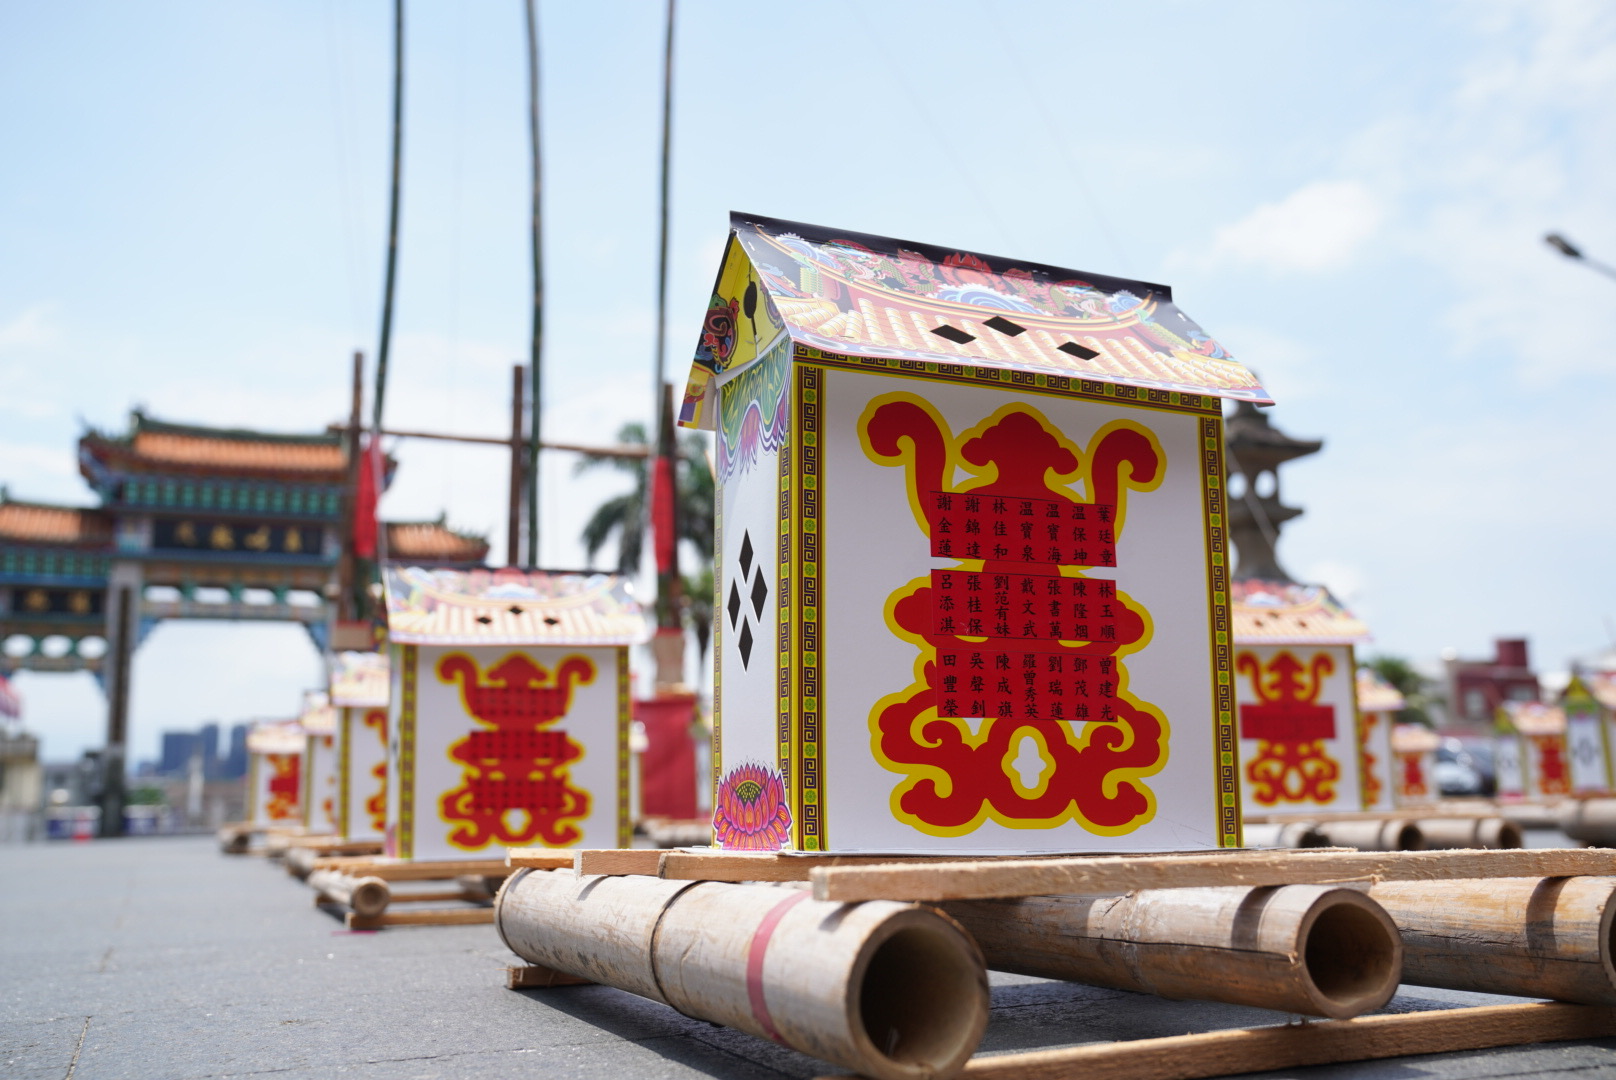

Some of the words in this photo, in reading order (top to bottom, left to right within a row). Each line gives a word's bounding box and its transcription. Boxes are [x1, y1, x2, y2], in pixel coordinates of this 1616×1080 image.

[937, 494, 953, 558] 謝金蓮
[964, 497, 981, 559] 謝錦達
[992, 499, 1008, 559] 林佳和
[967, 575, 984, 635] 張桂保
[994, 576, 1011, 637] 劉范有妹
[1021, 578, 1037, 638] 戴文武
[1047, 579, 1063, 638] 張書萬
[1098, 582, 1116, 640] 林玉順
[942, 654, 959, 717] 田豐榮
[996, 653, 1013, 718] 陳成旗
[1022, 654, 1039, 719] 羅曾秀英
[1048, 656, 1064, 720] 劉瑞蓮
[1098, 658, 1115, 721] 曾建光
